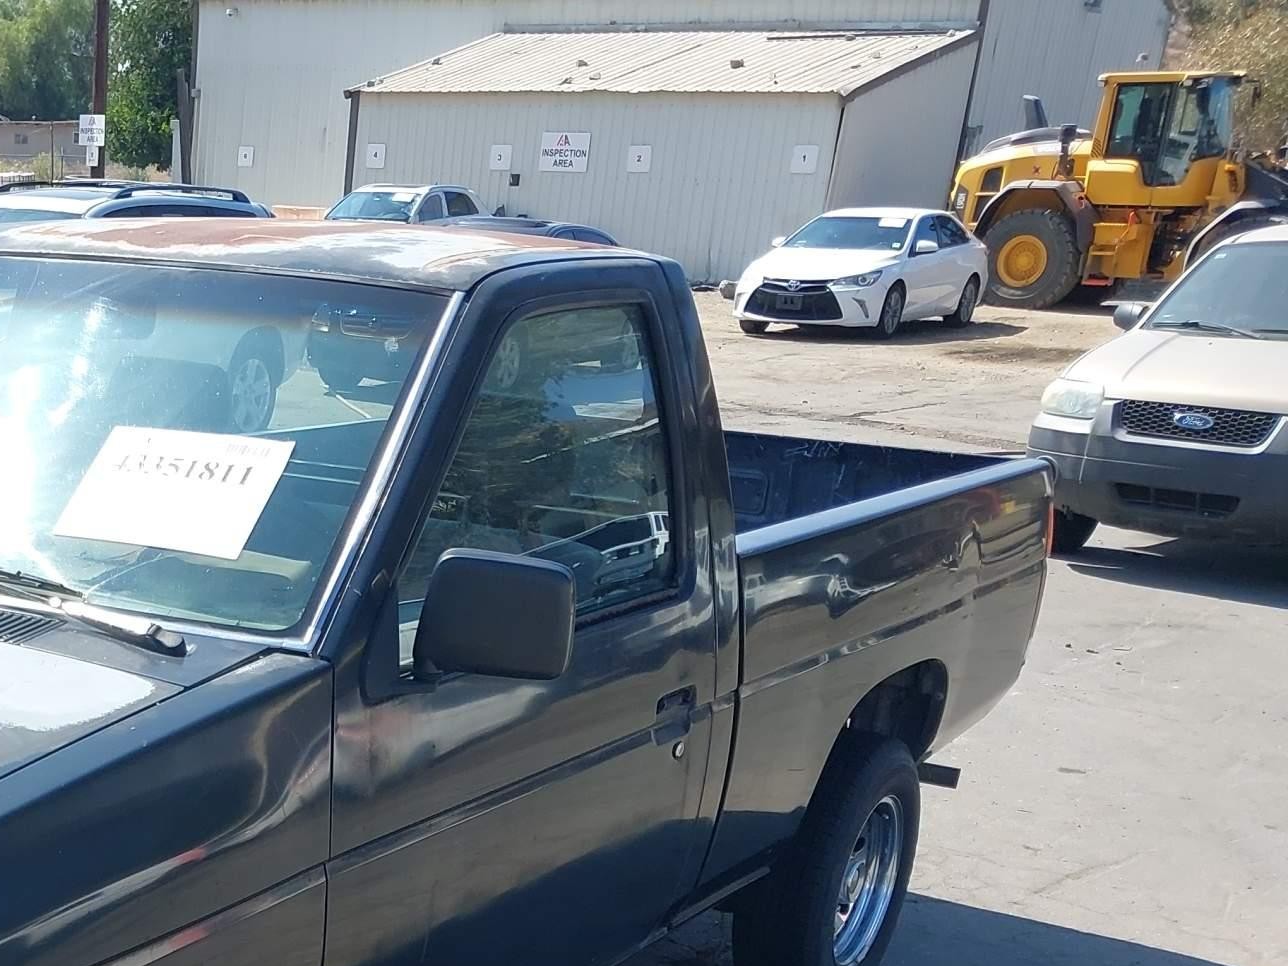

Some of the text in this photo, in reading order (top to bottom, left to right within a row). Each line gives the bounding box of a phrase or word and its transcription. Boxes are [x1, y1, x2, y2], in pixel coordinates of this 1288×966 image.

[542, 148, 587, 159] INSPECTION
[552, 159, 574, 168] AREA
[636, 155, 642, 163] 2
